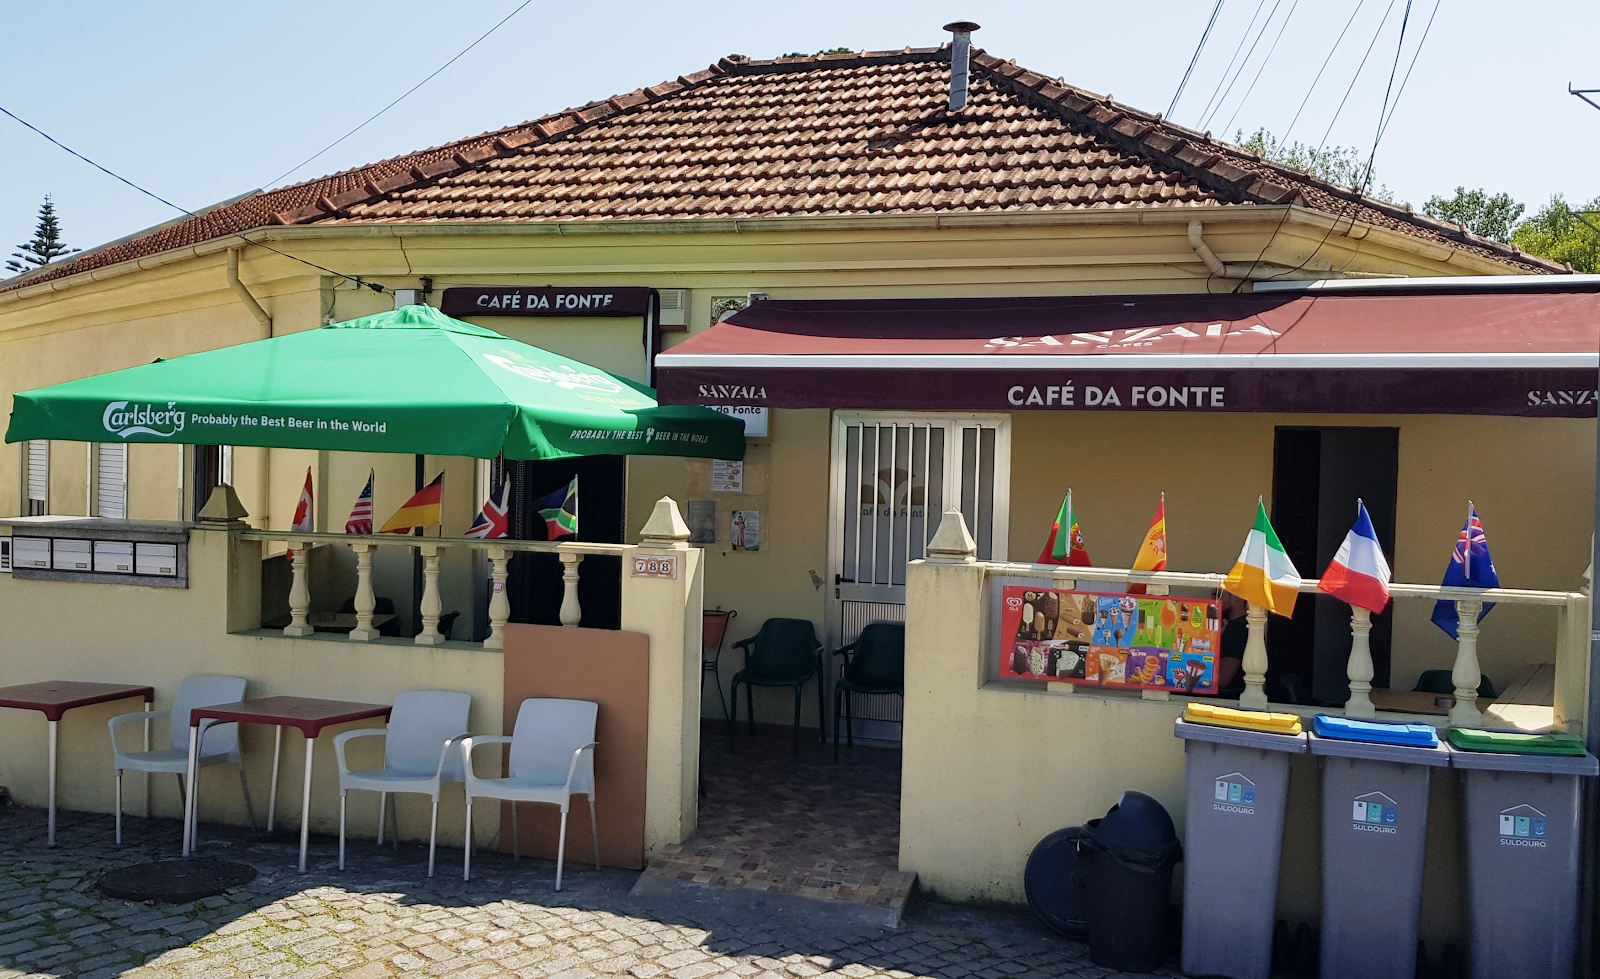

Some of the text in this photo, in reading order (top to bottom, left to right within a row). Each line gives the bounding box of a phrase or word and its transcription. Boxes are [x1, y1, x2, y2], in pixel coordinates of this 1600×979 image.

[476, 290, 613, 309] CAFÉ DA FONTE
[983, 323, 1282, 349] SANZALA
[698, 384, 768, 399] SANZALA
[1007, 379, 1225, 407] CAFÉ DA FONTE
[716, 405, 729, 414] da
[733, 405, 762, 414] Fonte
[102, 400, 186, 438] Carlsberg
[191, 413, 387, 433] Probably the Best Beer in the World
[570, 429, 709, 444] PROBABLY THE BEST BEER IN THE WORLD
[636, 561, 670, 572] 788
[1213, 803, 1255, 815] SULDOURO
[1352, 823, 1397, 834] SULDOURO
[1499, 838, 1547, 848] SULDOURO
